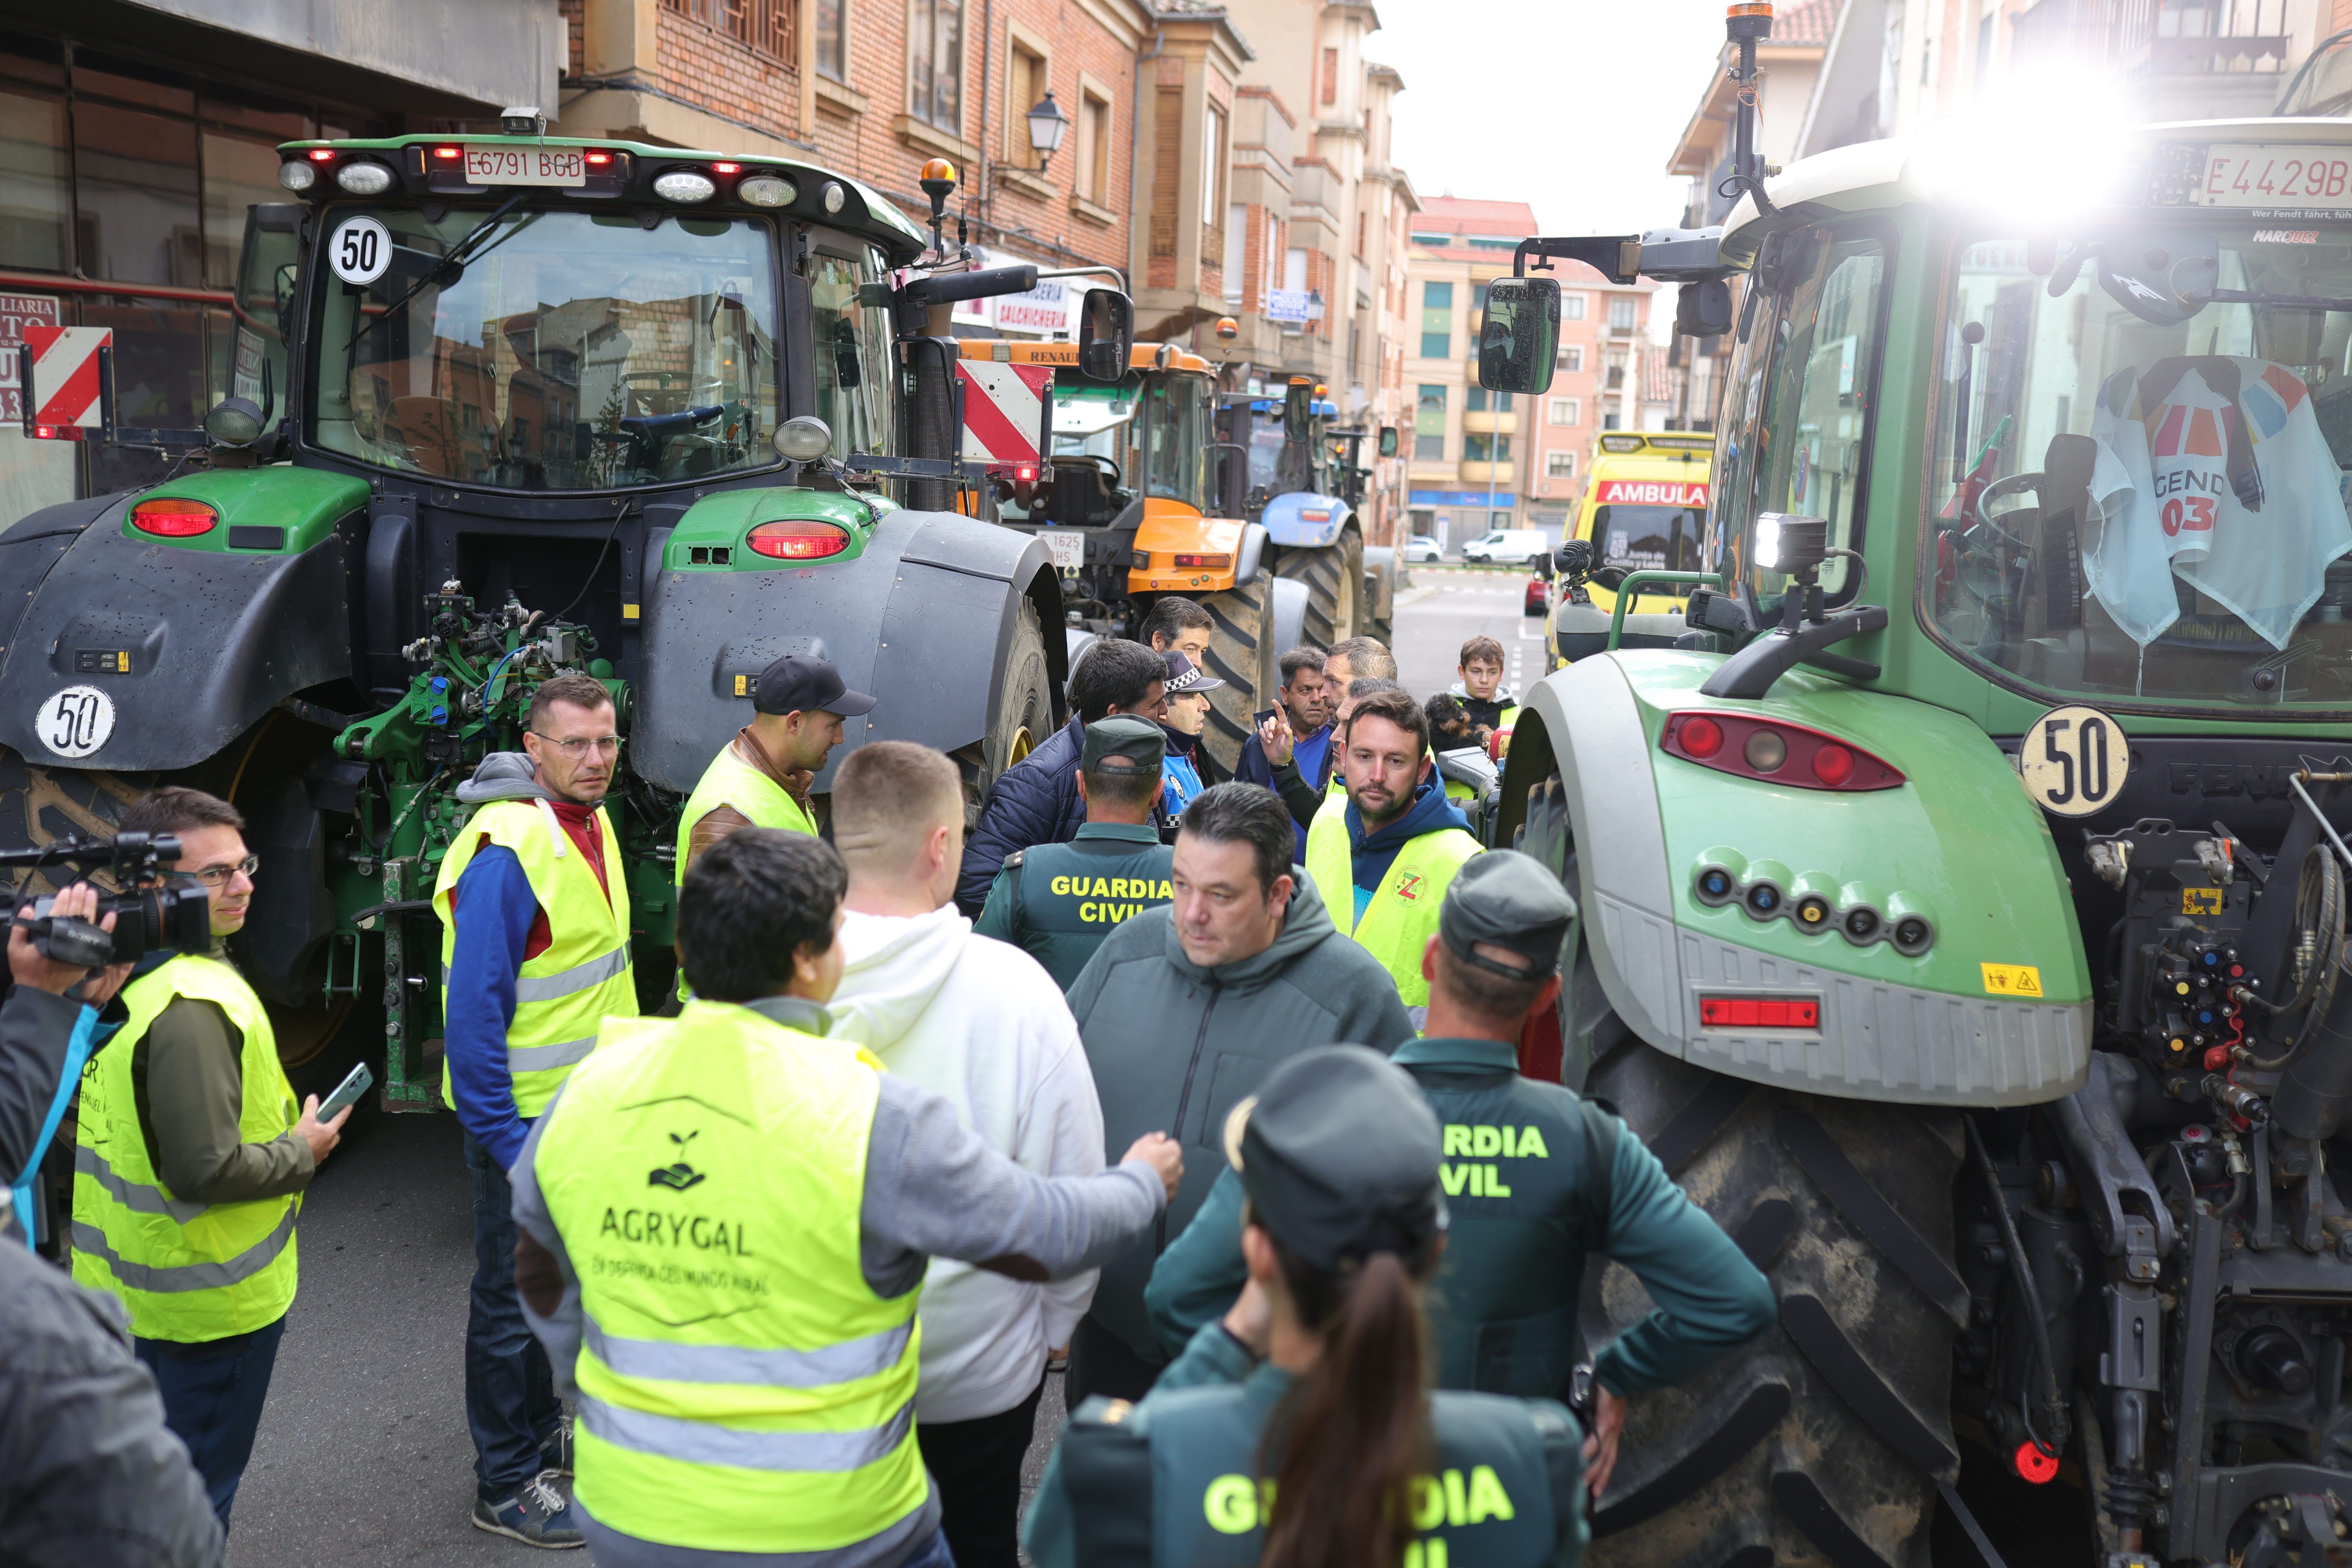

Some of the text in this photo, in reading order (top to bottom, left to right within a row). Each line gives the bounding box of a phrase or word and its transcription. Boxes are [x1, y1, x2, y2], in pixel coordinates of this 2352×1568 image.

[466, 151, 580, 177] E6791 BGD
[2207, 158, 2352, 196] E4429B
[2305, 210, 2331, 219] fährt,
[341, 229, 377, 272] 50
[0, 298, 53, 315] LIARIA
[1606, 483, 1706, 505] AMBULA
[2155, 469, 2224, 498] GEND
[2161, 496, 2220, 537] 03
[1054, 535, 1080, 548] 1625
[54, 694, 98, 750] 50
[2045, 717, 2108, 805] 50
[1051, 876, 1174, 899] GUARDIA
[1443, 1123, 1549, 1158] RDIA
[1437, 1161, 1512, 1198] VIL
[601, 1207, 753, 1257] AGRYGAL
[1204, 1464, 1515, 1535] GDIA
